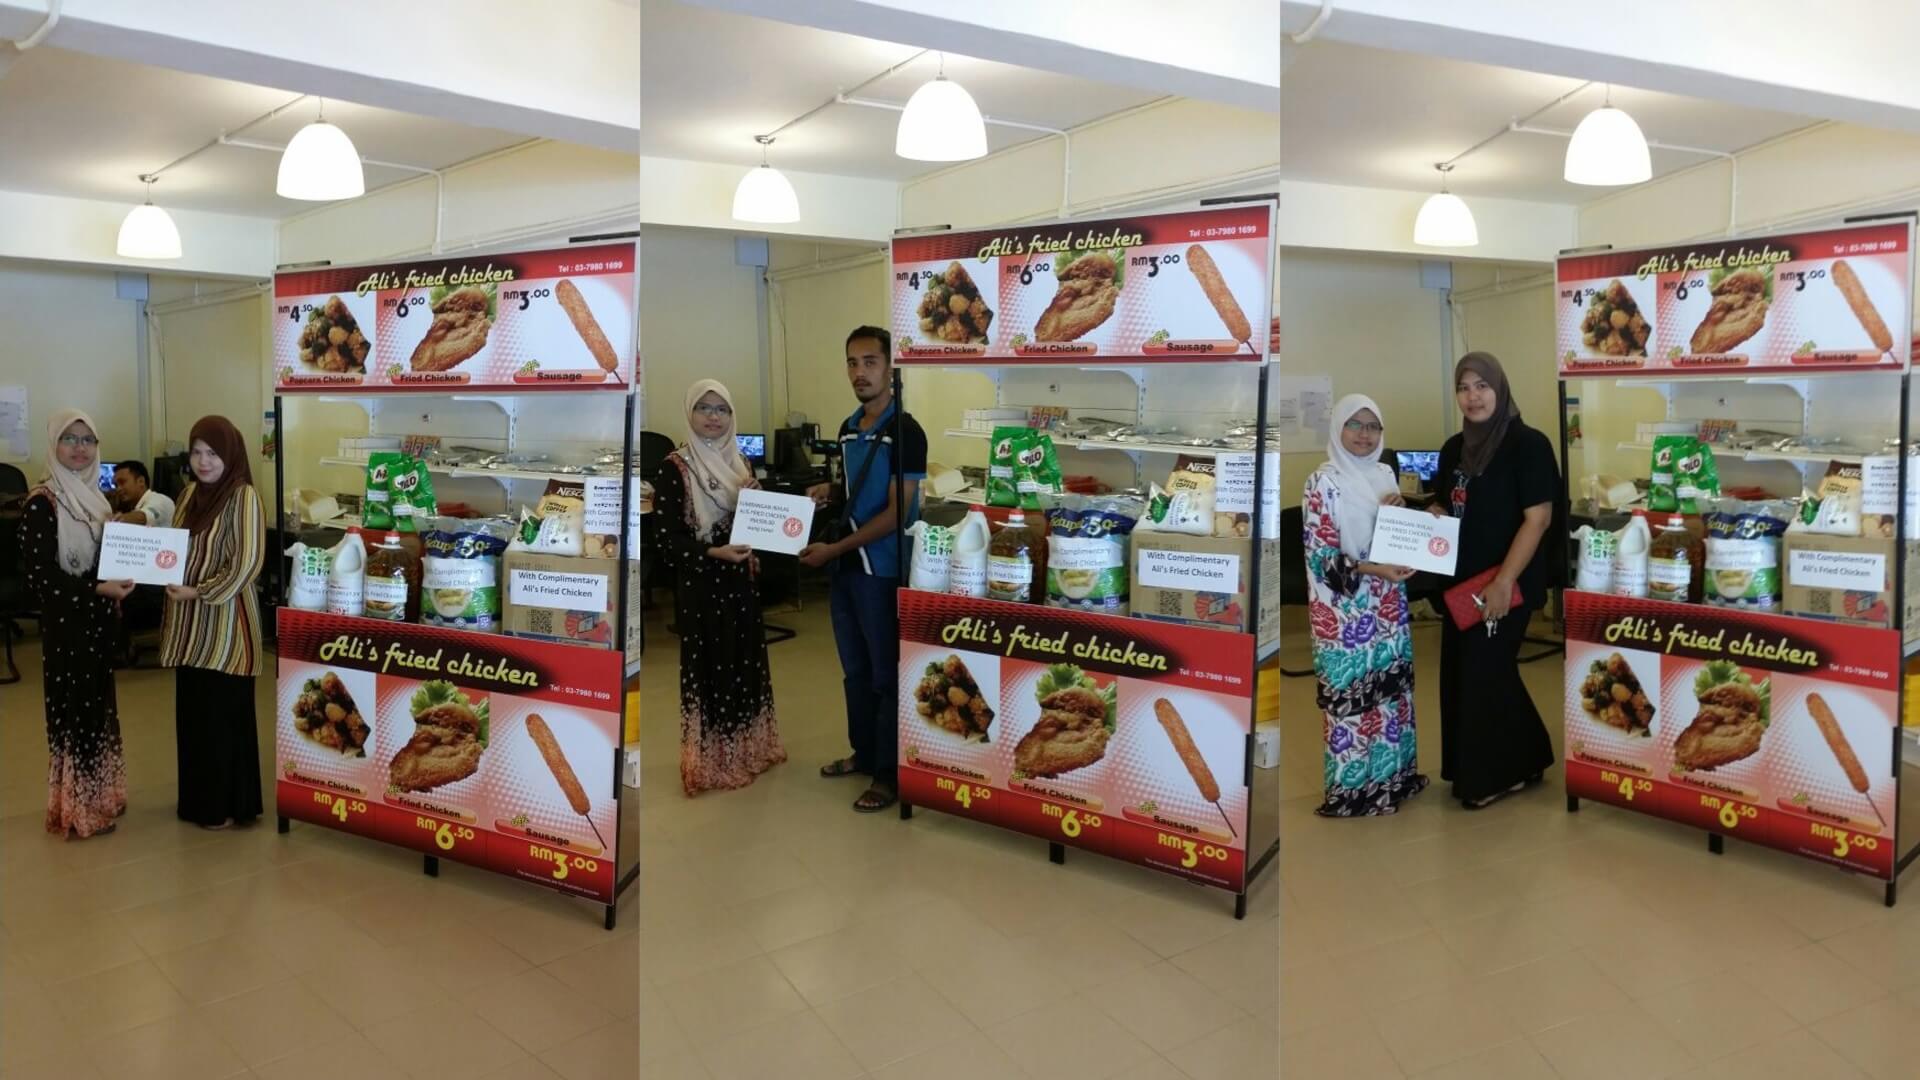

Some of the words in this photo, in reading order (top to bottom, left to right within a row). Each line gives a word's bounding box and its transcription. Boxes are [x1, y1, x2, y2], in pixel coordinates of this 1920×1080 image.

[1189, 229, 1201, 237] Tel
[978, 237, 1023, 262] Ali's
[1027, 235, 1071, 261] fried
[1075, 228, 1142, 250] chicken
[1833, 246, 1845, 254] Tel
[559, 264, 571, 273] Tel
[1637, 254, 1680, 280] Ali's
[1681, 253, 1724, 279] fried
[1727, 247, 1790, 268] chicken
[356, 270, 401, 297] Ali's
[401, 270, 447, 299] fried
[450, 263, 515, 284] chicken
[909, 346, 941, 355] Popcorn
[943, 345, 978, 355] Chicken
[1024, 343, 1048, 353] Fried
[1050, 343, 1088, 353] Chicken
[1166, 341, 1214, 353] Sausage
[1573, 361, 1602, 369] Popcorn
[1604, 359, 1637, 368] Chicken
[1681, 357, 1703, 366] Fried
[1705, 356, 1740, 365] Chicken
[1814, 352, 1858, 363] Sausage
[290, 376, 321, 385] Popcorn
[322, 375, 356, 384] Chicken
[400, 373, 424, 383] Fried
[426, 373, 461, 382] Chicken
[537, 372, 582, 382] Sausage
[1146, 552, 1165, 560] With
[1167, 553, 1230, 566] Complimentary
[1798, 552, 1814, 560] With
[1817, 553, 1876, 565] Complimentary
[1152, 565, 1168, 573] Ali's
[1170, 566, 1189, 576] Fried
[1192, 568, 1224, 579] Chicken
[1802, 565, 1817, 573] Ali's
[1819, 566, 1837, 574] Fried
[1839, 568, 1870, 577] Chicken
[518, 572, 536, 580] With
[538, 573, 599, 586] Complimentary
[522, 585, 539, 593] Ali's
[540, 586, 559, 595] Fried
[561, 588, 592, 598] Chicken
[942, 617, 1002, 644] Ali's
[1006, 625, 1066, 656] fried
[1073, 638, 1167, 670] chicken
[1605, 616, 1662, 643] Ali's
[1665, 624, 1722, 655] fried
[1728, 636, 1818, 667] chicken
[320, 635, 378, 662] Ali's
[382, 642, 440, 673] fried
[447, 655, 539, 687] chicken
[1179, 667, 1191, 677] Tel
[1829, 663, 1840, 673] Tel
[549, 684, 560, 693] Tel
[915, 758, 949, 772] Popcorn
[951, 765, 986, 780] Chicken
[1580, 752, 1613, 766] Popcorn
[1615, 759, 1647, 774] Chicken
[293, 772, 325, 786] Popcorn
[327, 779, 361, 794] Chicken
[1683, 776, 1705, 789] Fried
[1707, 780, 1744, 796] Chicken
[1023, 783, 1048, 796] Fried
[1048, 788, 1087, 805] Chicken
[398, 797, 422, 810] Fried
[424, 802, 461, 818] Chicken
[1807, 807, 1850, 824] Sausage
[1153, 814, 1199, 833] Sausage
[525, 827, 570, 845] Sausage
